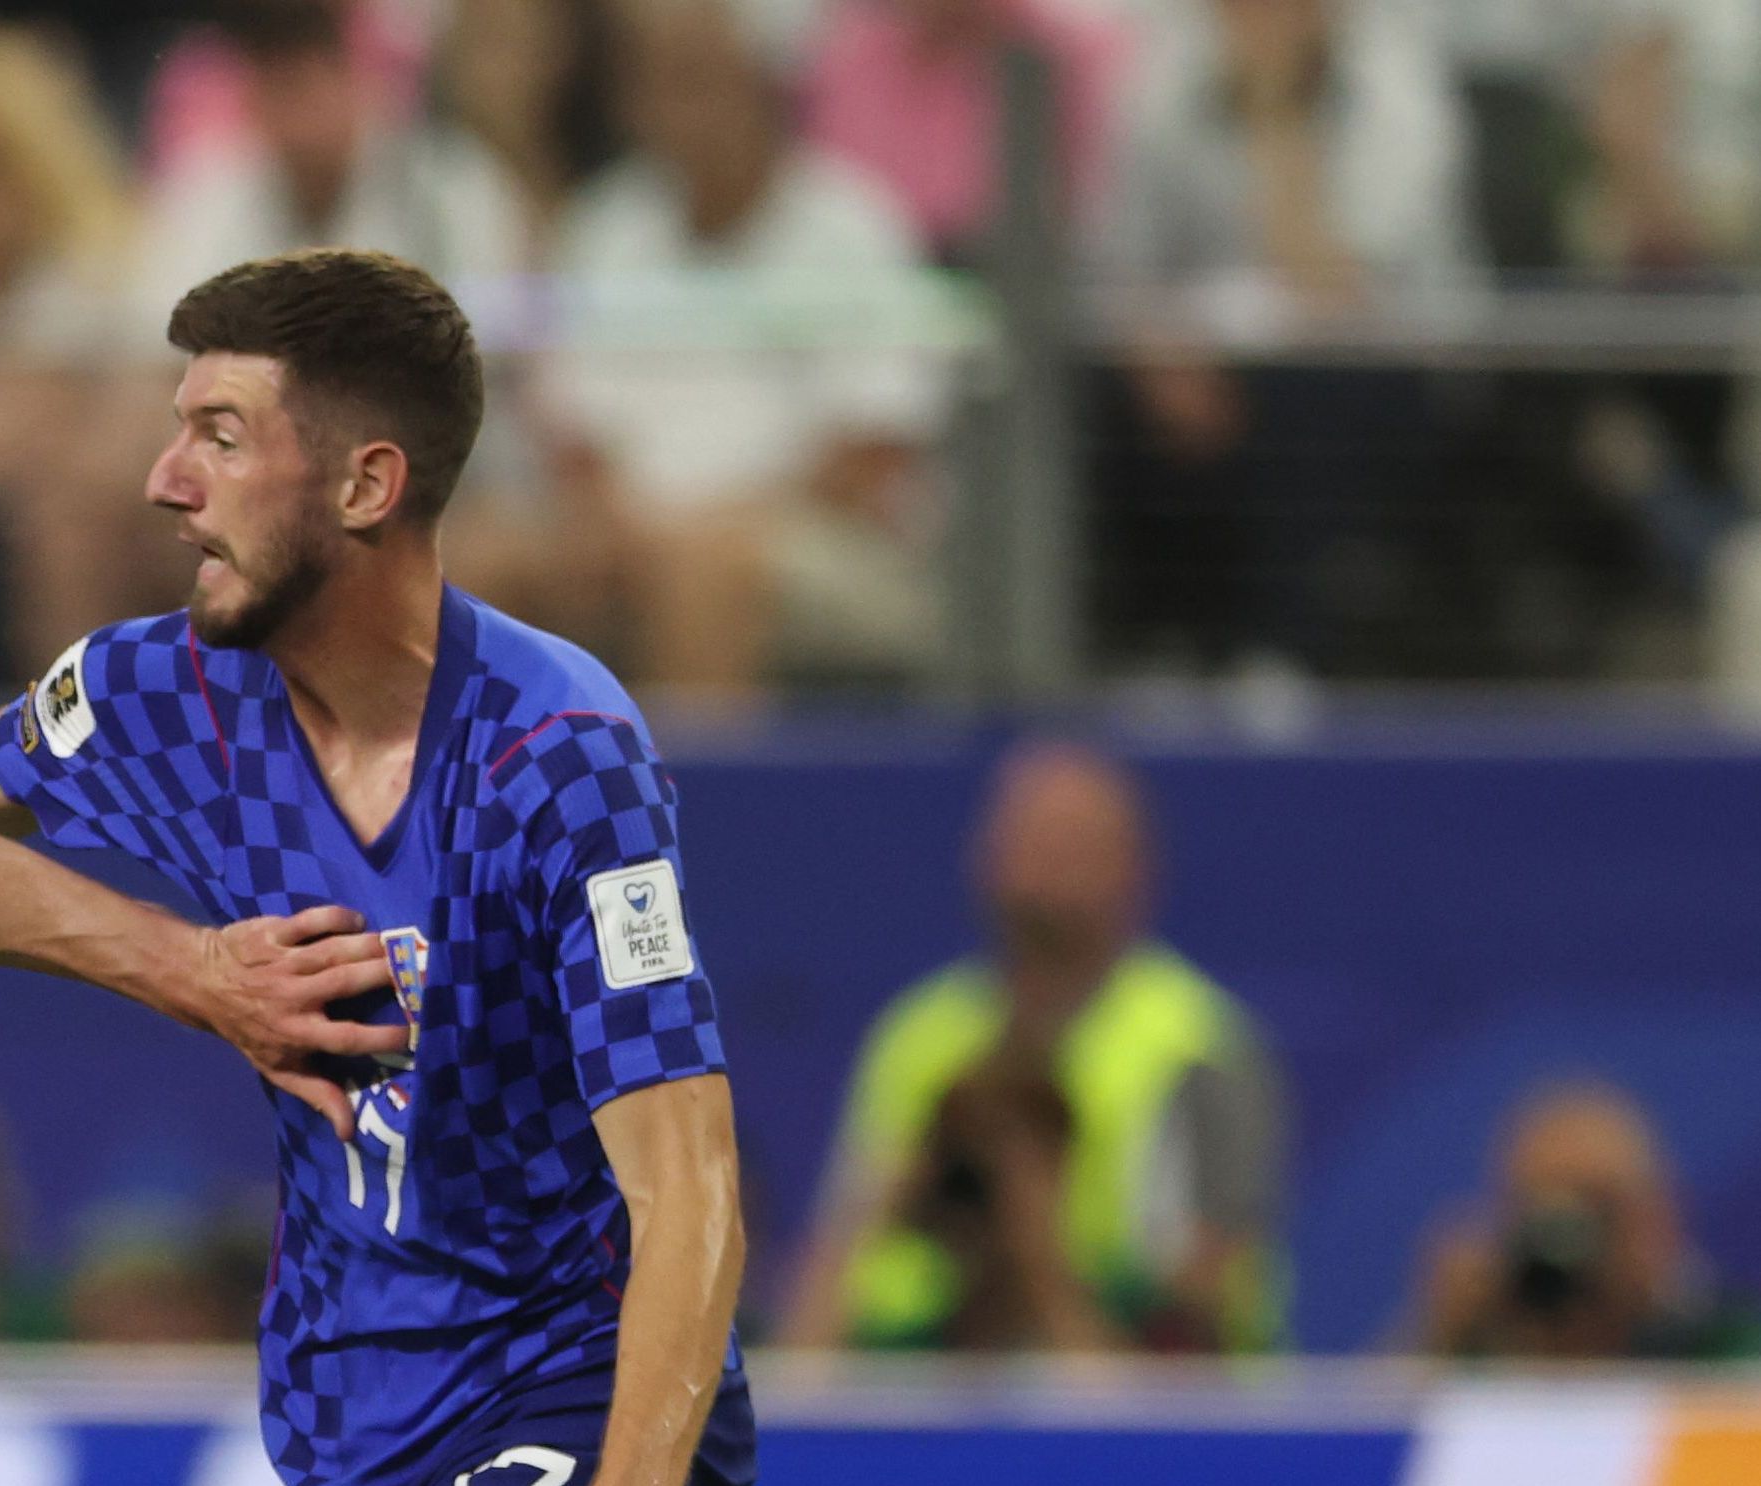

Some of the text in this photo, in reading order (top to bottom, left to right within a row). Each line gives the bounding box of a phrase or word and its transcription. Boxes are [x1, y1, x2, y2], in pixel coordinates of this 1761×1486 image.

[628, 933, 671, 958] PEACE
[641, 956, 666, 969] FIFA
[343, 1086, 407, 1237] 17
